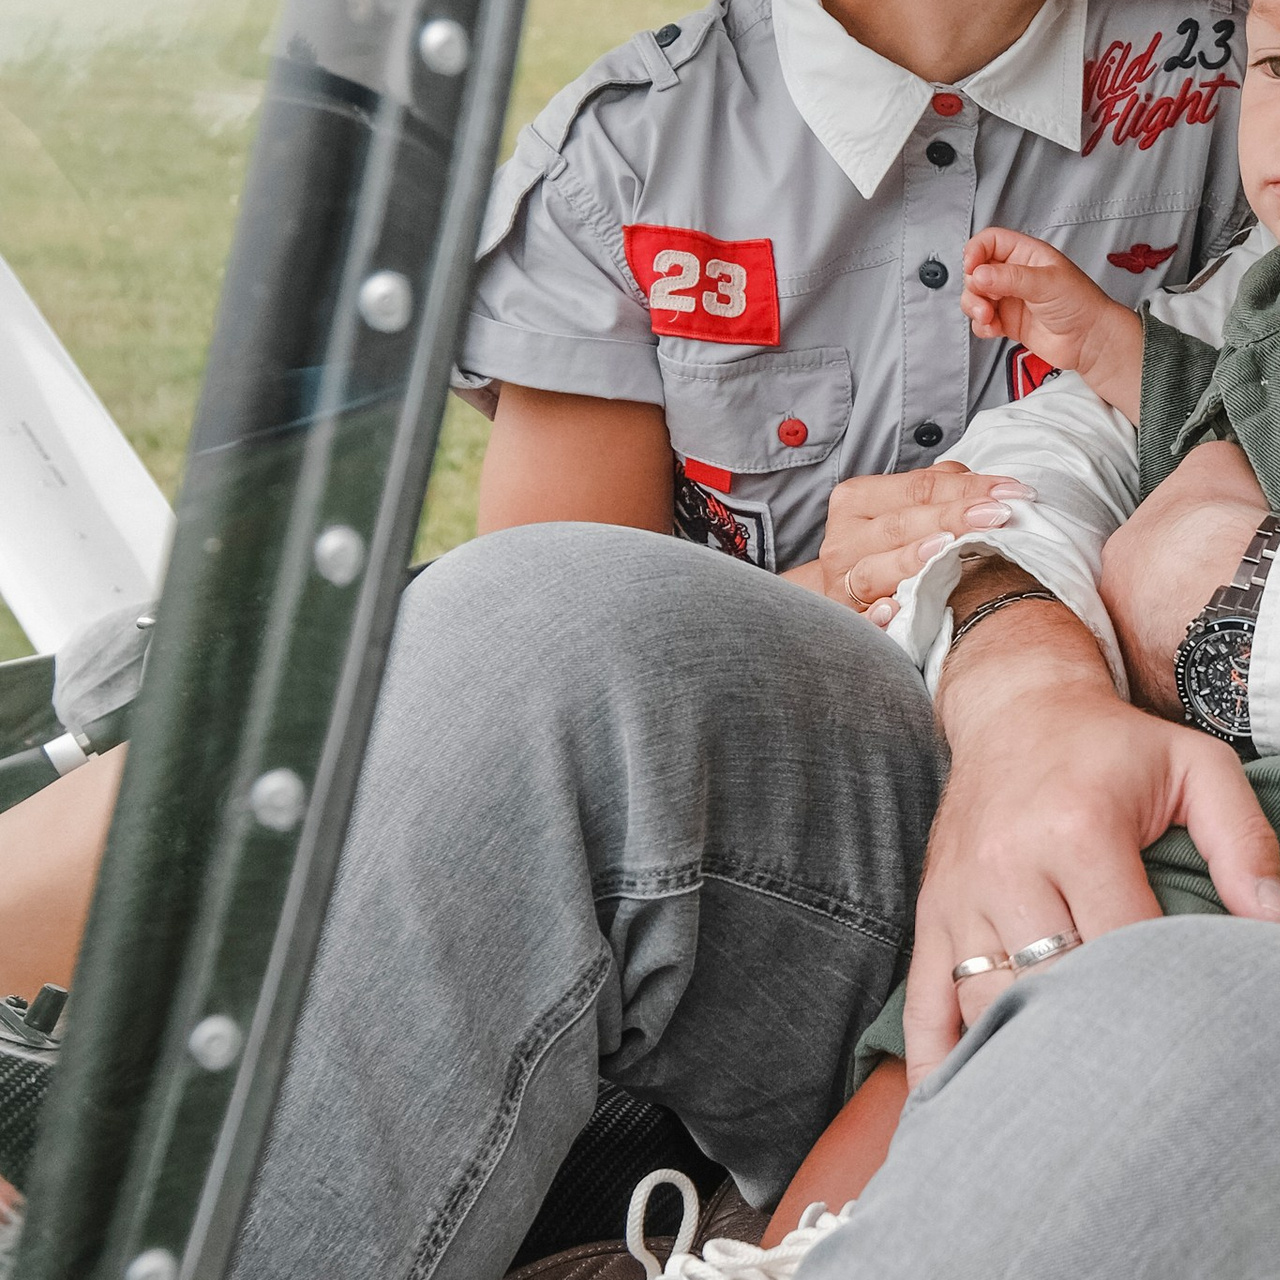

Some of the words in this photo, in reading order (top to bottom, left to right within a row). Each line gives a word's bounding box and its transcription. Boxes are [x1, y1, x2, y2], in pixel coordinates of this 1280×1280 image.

[1163, 17, 1236, 73] 23
[1081, 72, 1241, 158] Flight
[650, 249, 748, 318] 23
